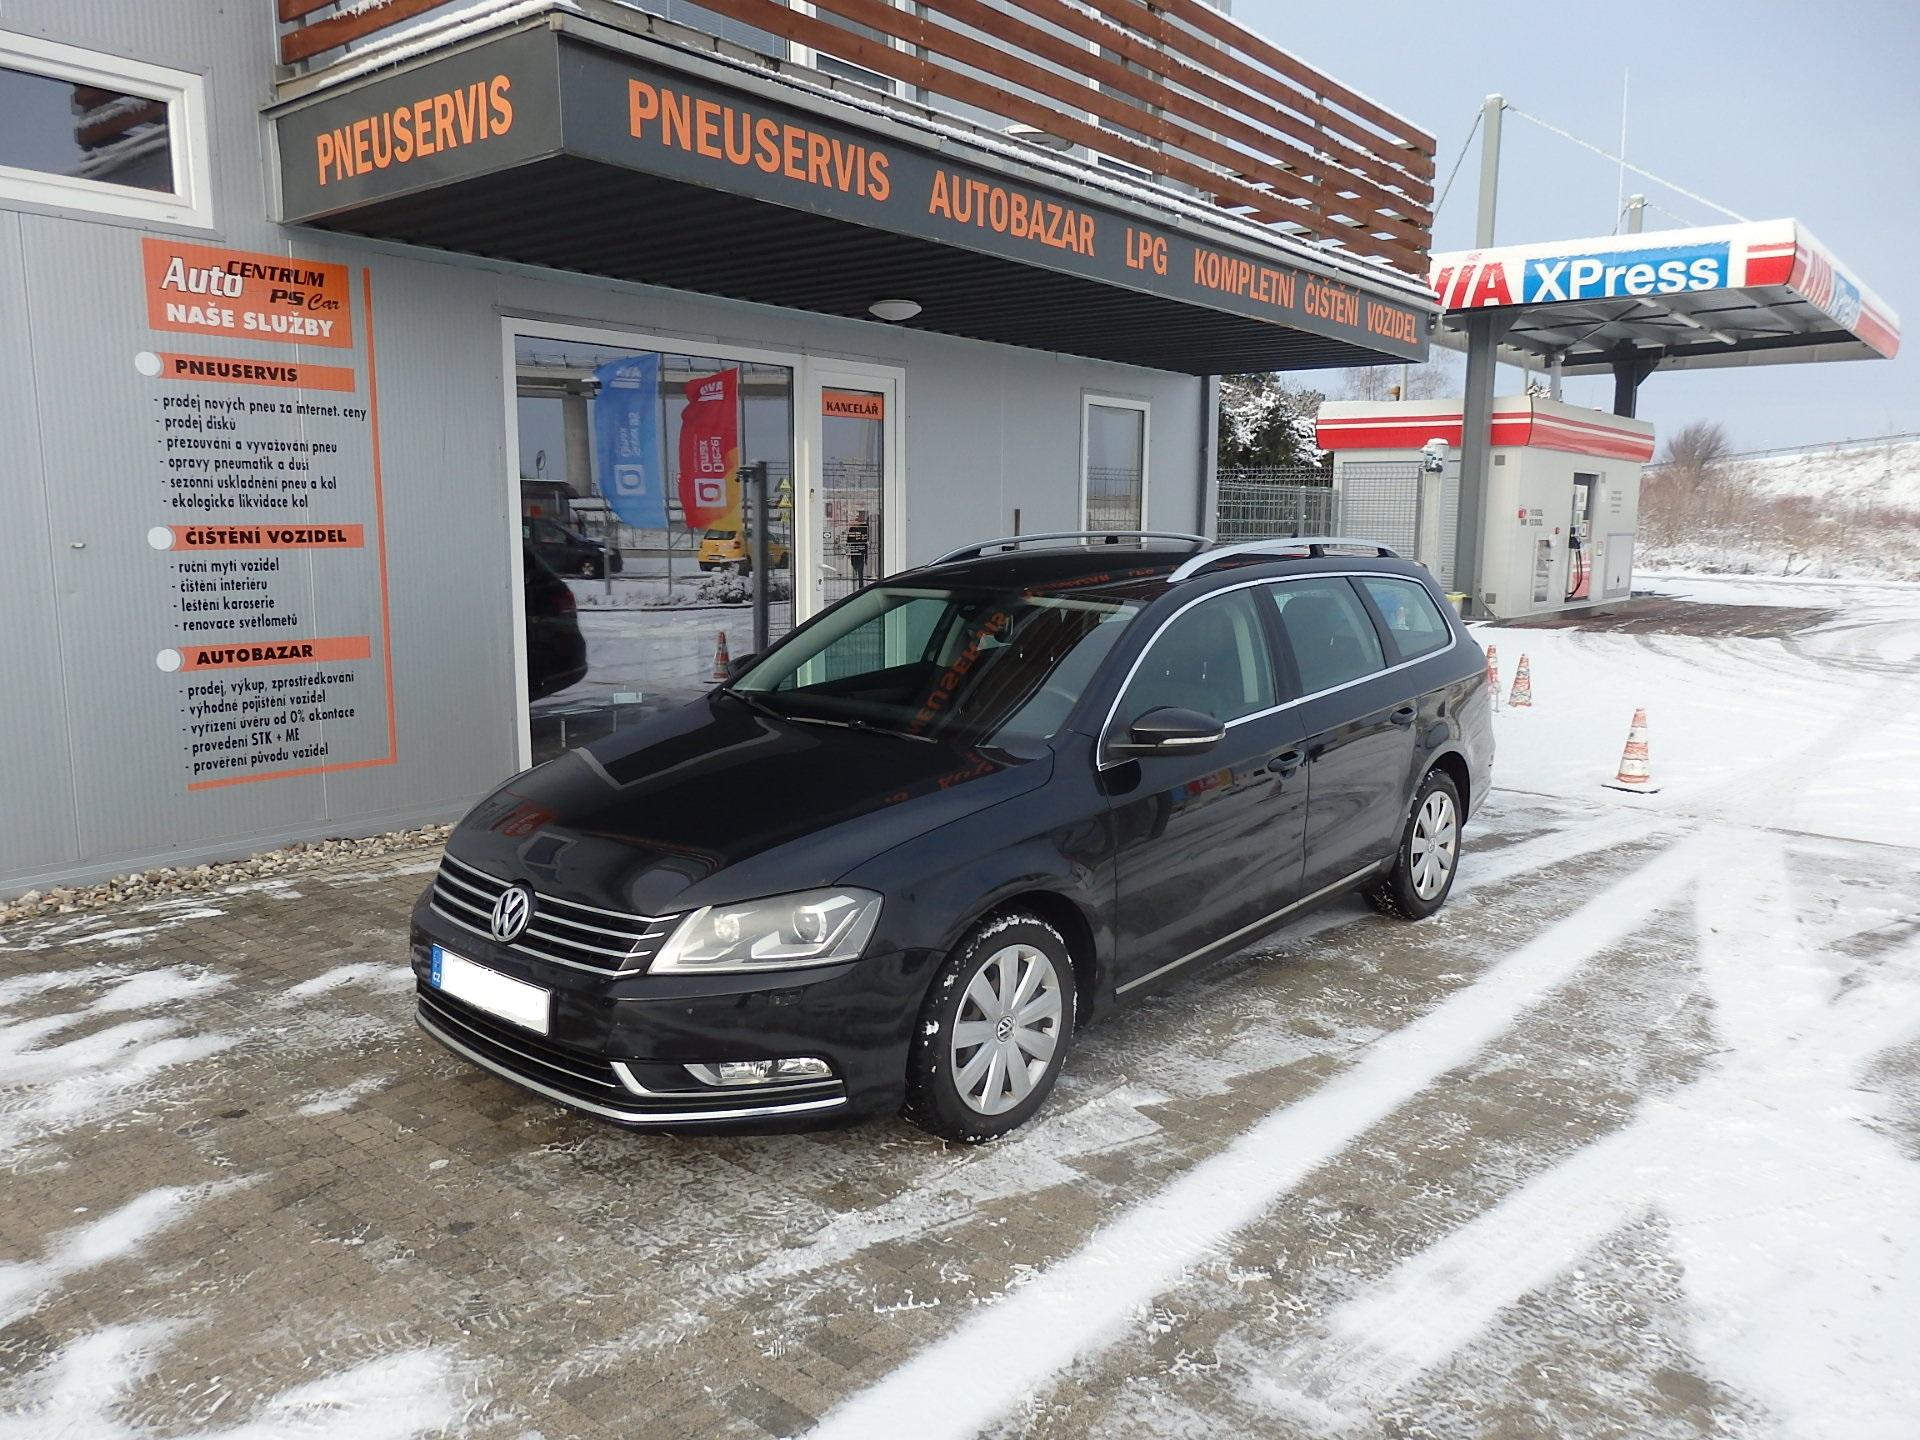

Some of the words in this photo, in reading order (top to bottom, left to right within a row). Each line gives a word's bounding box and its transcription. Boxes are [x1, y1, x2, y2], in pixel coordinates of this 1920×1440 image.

[316, 74, 513, 185] PNEUSERVIS
[628, 79, 890, 201] PNEUSERVIS
[928, 170, 1095, 257] AUTOBAZAR
[1126, 227, 1168, 276] LPG
[1193, 248, 1297, 309] KOMPLETNÍ
[1304, 273, 1361, 326] ČIŠTĚNÍ
[1367, 301, 1417, 344] VOZIDEL
[160, 255, 244, 298] Auto
[227, 260, 325, 287] CENTRUM
[1532, 256, 1720, 302] XPress
[270, 289, 304, 306] PS
[307, 293, 341, 311] Car
[166, 302, 235, 328] NAŠE
[243, 311, 333, 337] SLUŽBY
[175, 359, 298, 382] PNEUSERVIS
[163, 394, 200, 412] prodej
[205, 397, 245, 413] nových
[249, 402, 276, 414] pneu
[279, 403, 292, 413] za
[296, 400, 340, 416] internet.
[343, 408, 366, 421] ceny
[826, 401, 879, 415] KANCELÁŘ
[165, 414, 202, 432] prodej
[166, 436, 231, 451] přezouvání
[235, 441, 242, 450] a
[312, 443, 337, 455] pneu
[169, 458, 209, 472] opravy
[214, 456, 273, 472] pneumatik
[278, 461, 284, 470] a
[282, 480, 307, 492] pneu
[310, 480, 317, 489] a
[320, 476, 337, 489] kol
[172, 493, 234, 511] ekologická
[239, 493, 288, 508] likvidace
[292, 494, 308, 507] kol
[185, 526, 261, 545] ČIŠTĚNÍ
[267, 529, 347, 544] VOZIDEL
[179, 560, 207, 573] ruční
[241, 557, 279, 571] vozidel
[181, 578, 217, 592] čištění
[221, 577, 267, 591] interiéru
[182, 597, 219, 612] leštění
[224, 595, 275, 610] karoserie
[183, 620, 235, 631] renovace
[240, 613, 297, 629] světlometů
[197, 644, 313, 665] AUTOBAZAR
[188, 680, 226, 700] prodej,
[231, 678, 268, 695] výkup,
[272, 671, 354, 691] zprostředkování
[290, 689, 326, 705] vozidel
[274, 711, 287, 724] od
[290, 709, 305, 723] 0%
[309, 708, 355, 722] akontace
[251, 731, 272, 746] STK
[285, 728, 300, 742] ME
[251, 747, 289, 767] původu
[292, 742, 329, 759] vozidel
